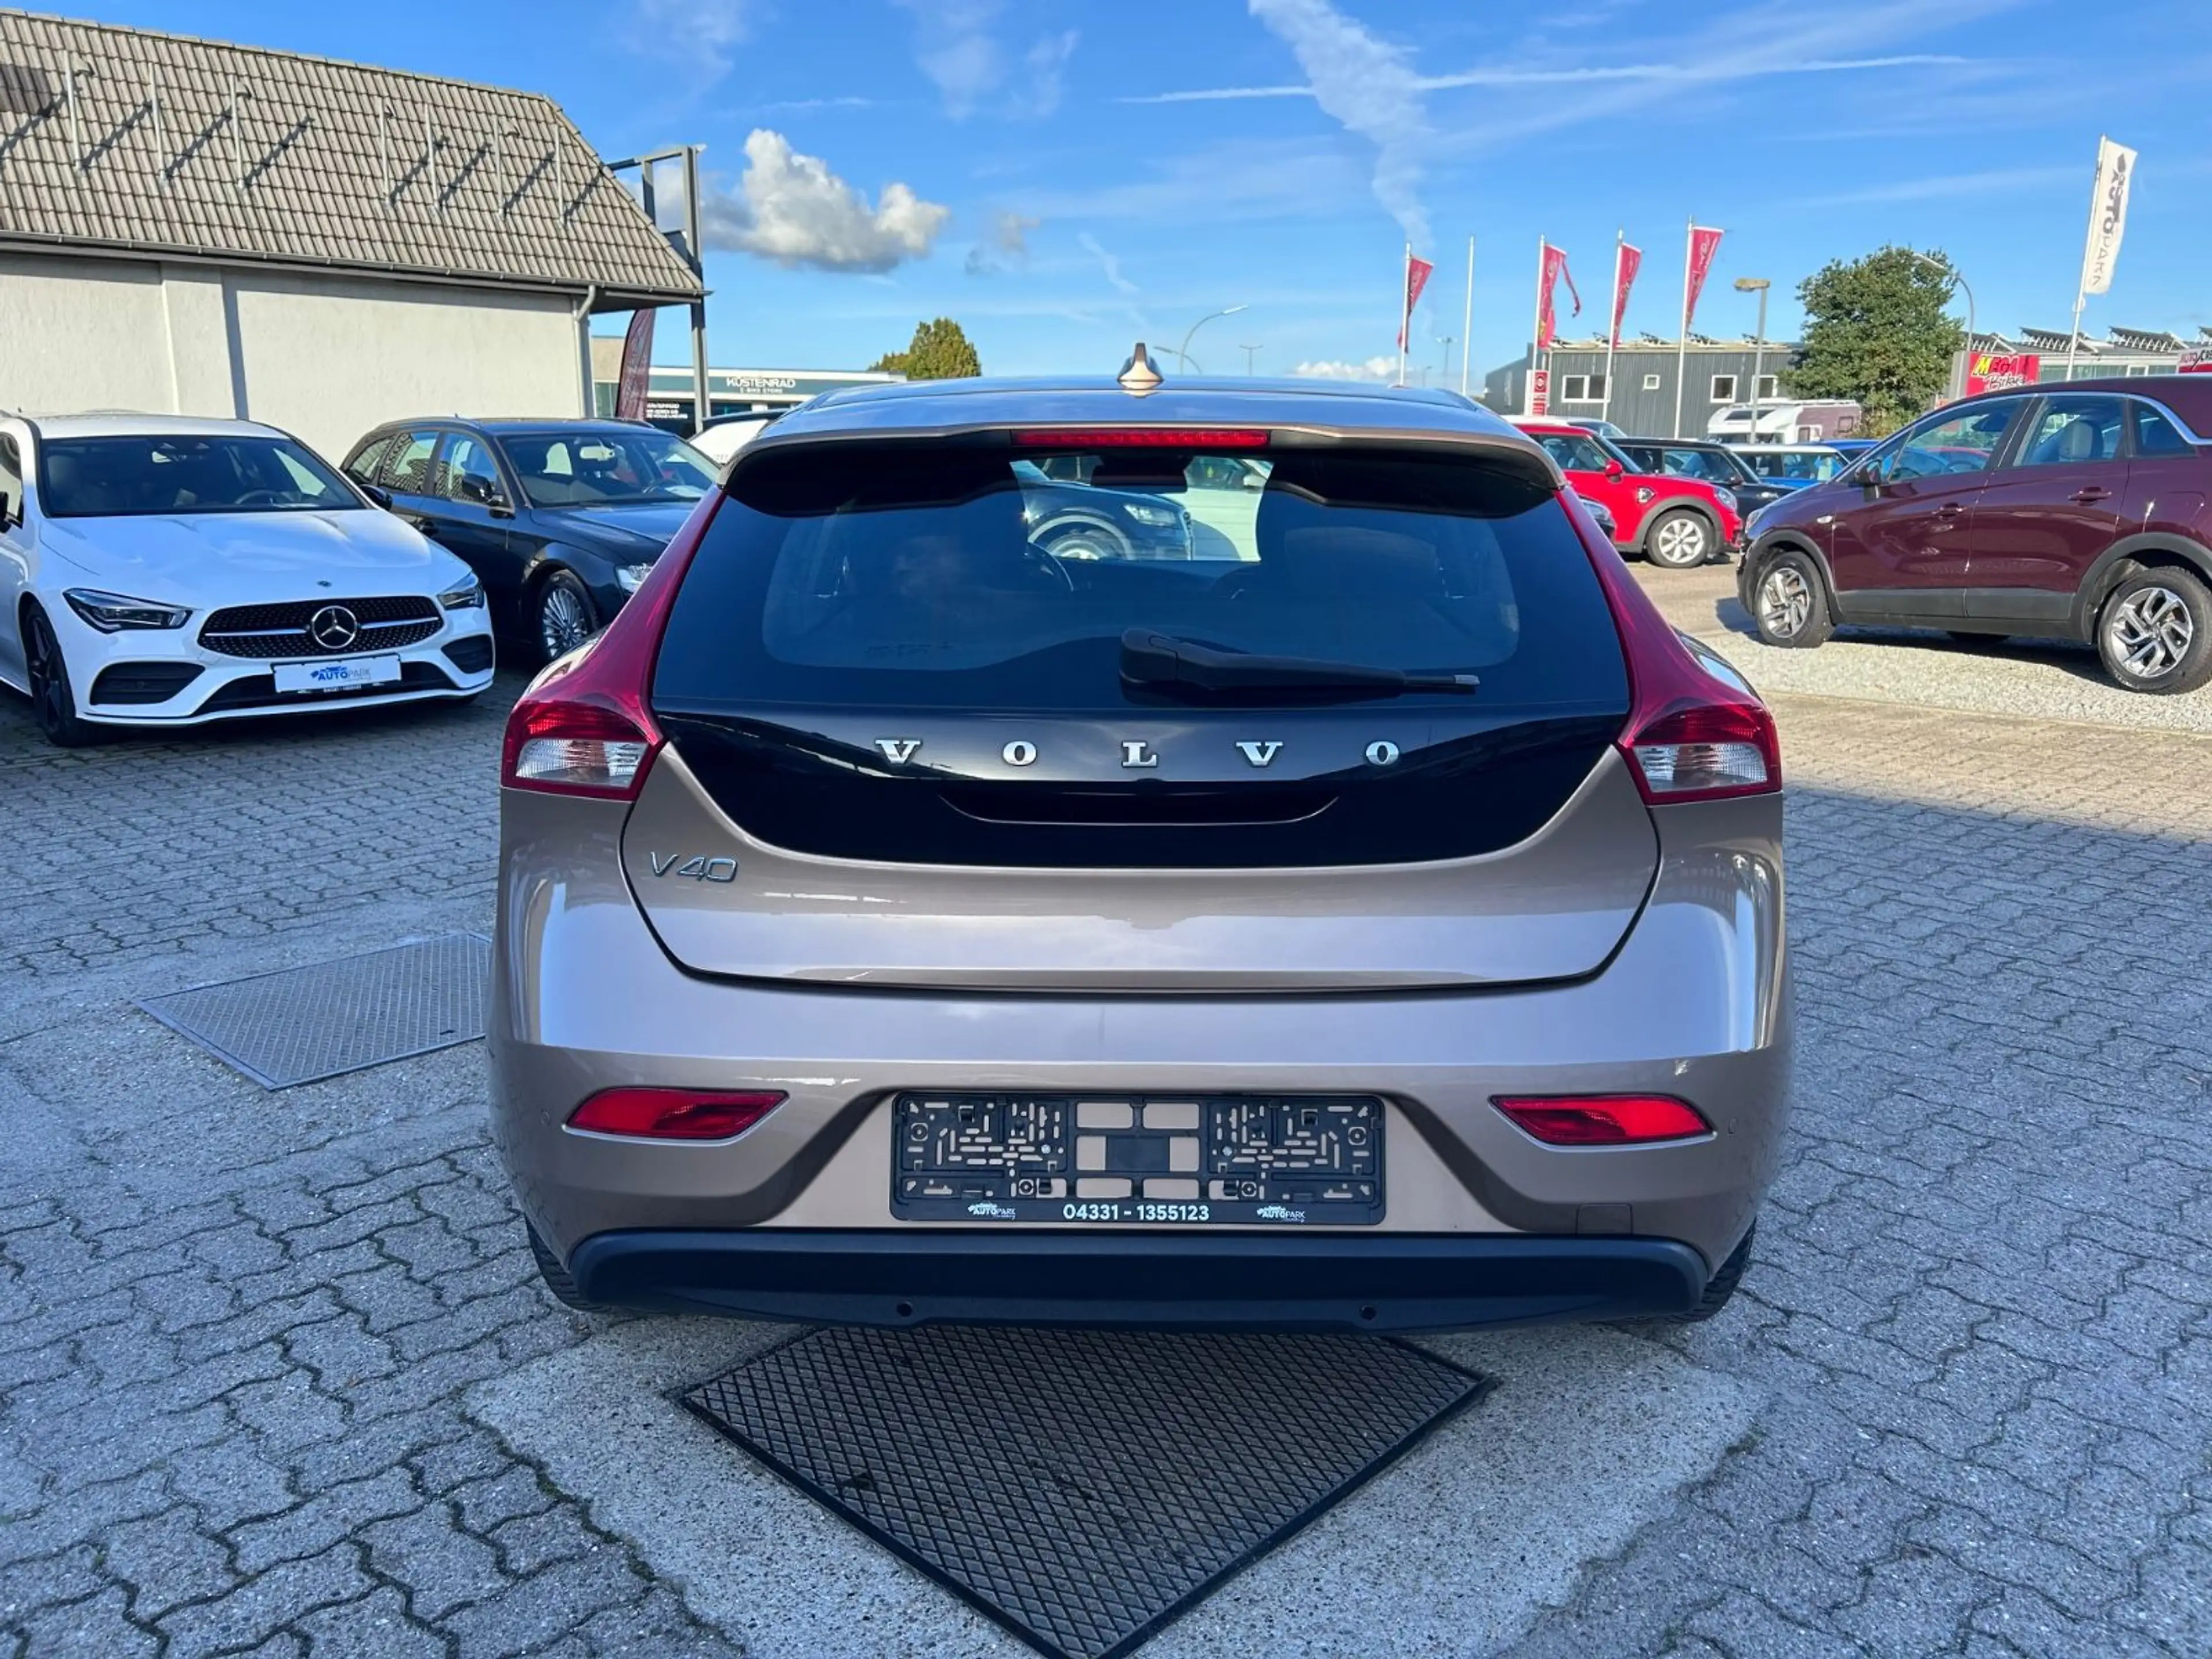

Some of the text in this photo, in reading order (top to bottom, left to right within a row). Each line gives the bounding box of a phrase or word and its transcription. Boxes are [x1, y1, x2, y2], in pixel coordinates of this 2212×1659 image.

[874, 739, 1400, 767] VOLVO
[650, 851, 737, 883] V40
[1063, 1204, 1119, 1220] 04331
[1137, 1205, 1210, 1221] 1355123
